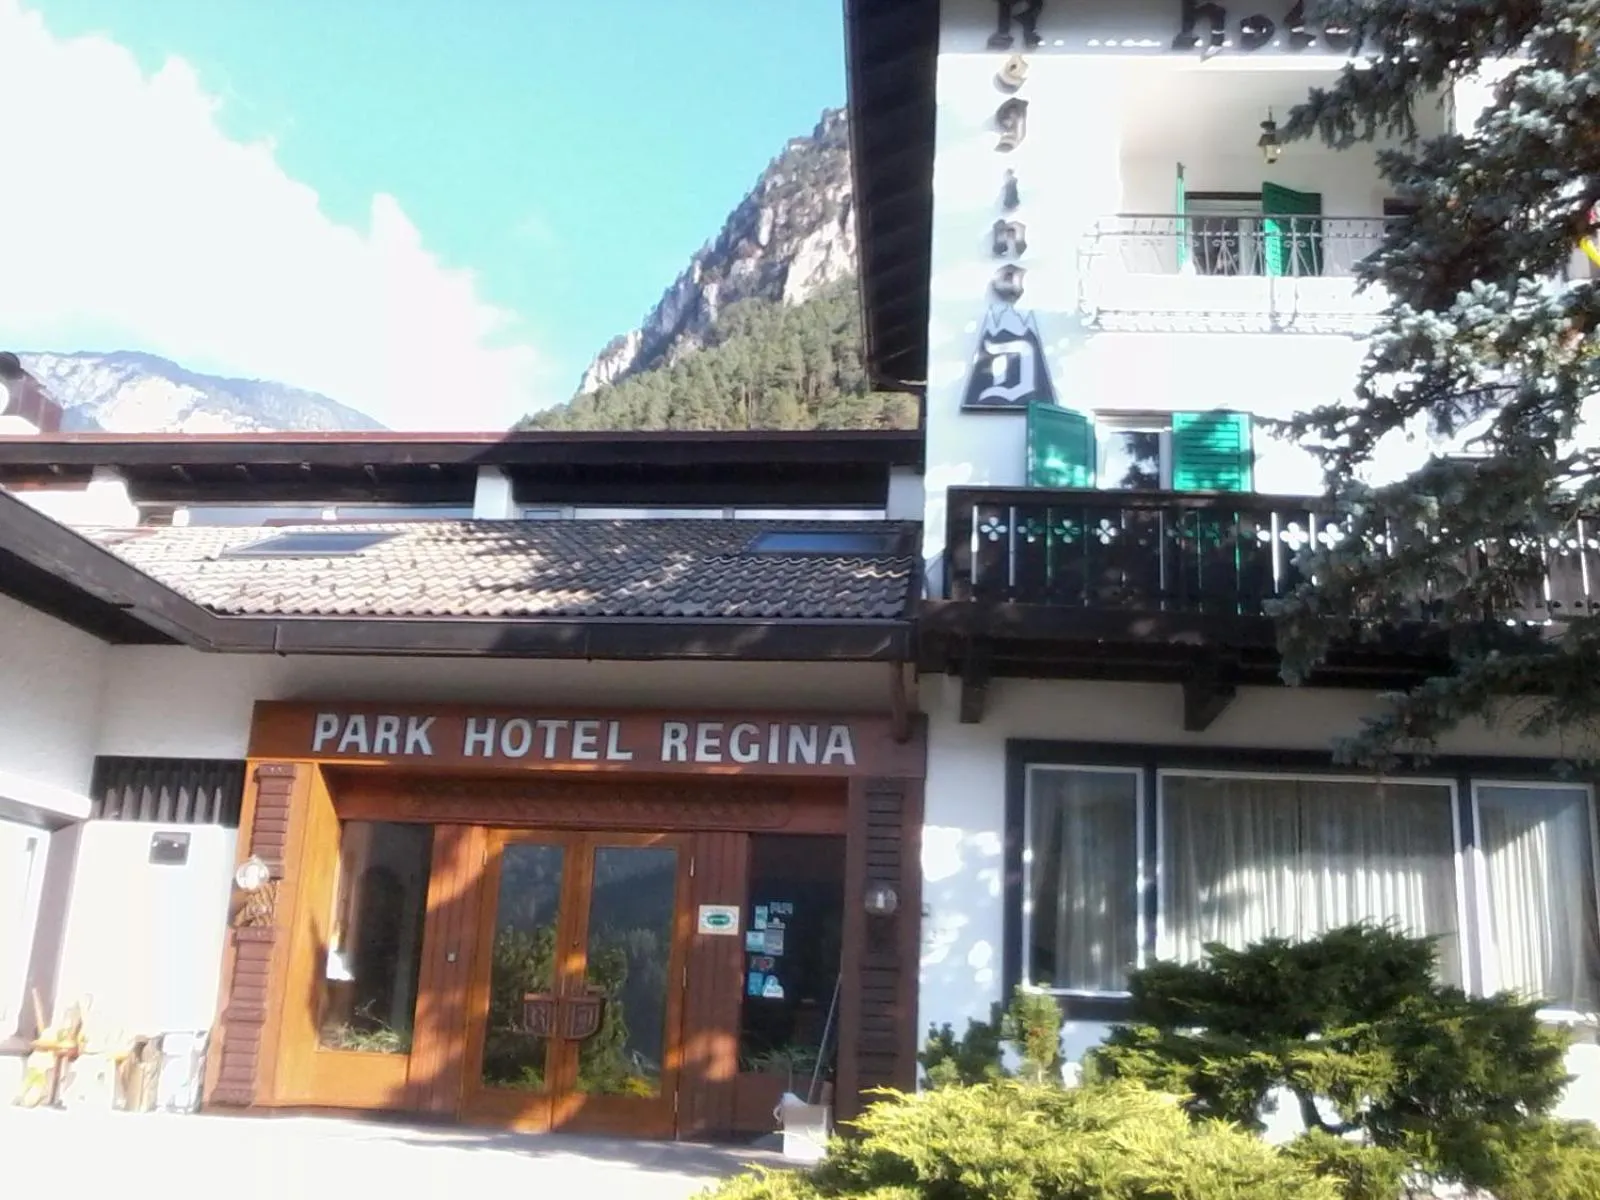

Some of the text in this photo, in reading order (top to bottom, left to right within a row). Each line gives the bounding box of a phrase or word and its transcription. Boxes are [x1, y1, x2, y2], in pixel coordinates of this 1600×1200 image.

[312, 713, 856, 765] PARK HOTEL REGINA
